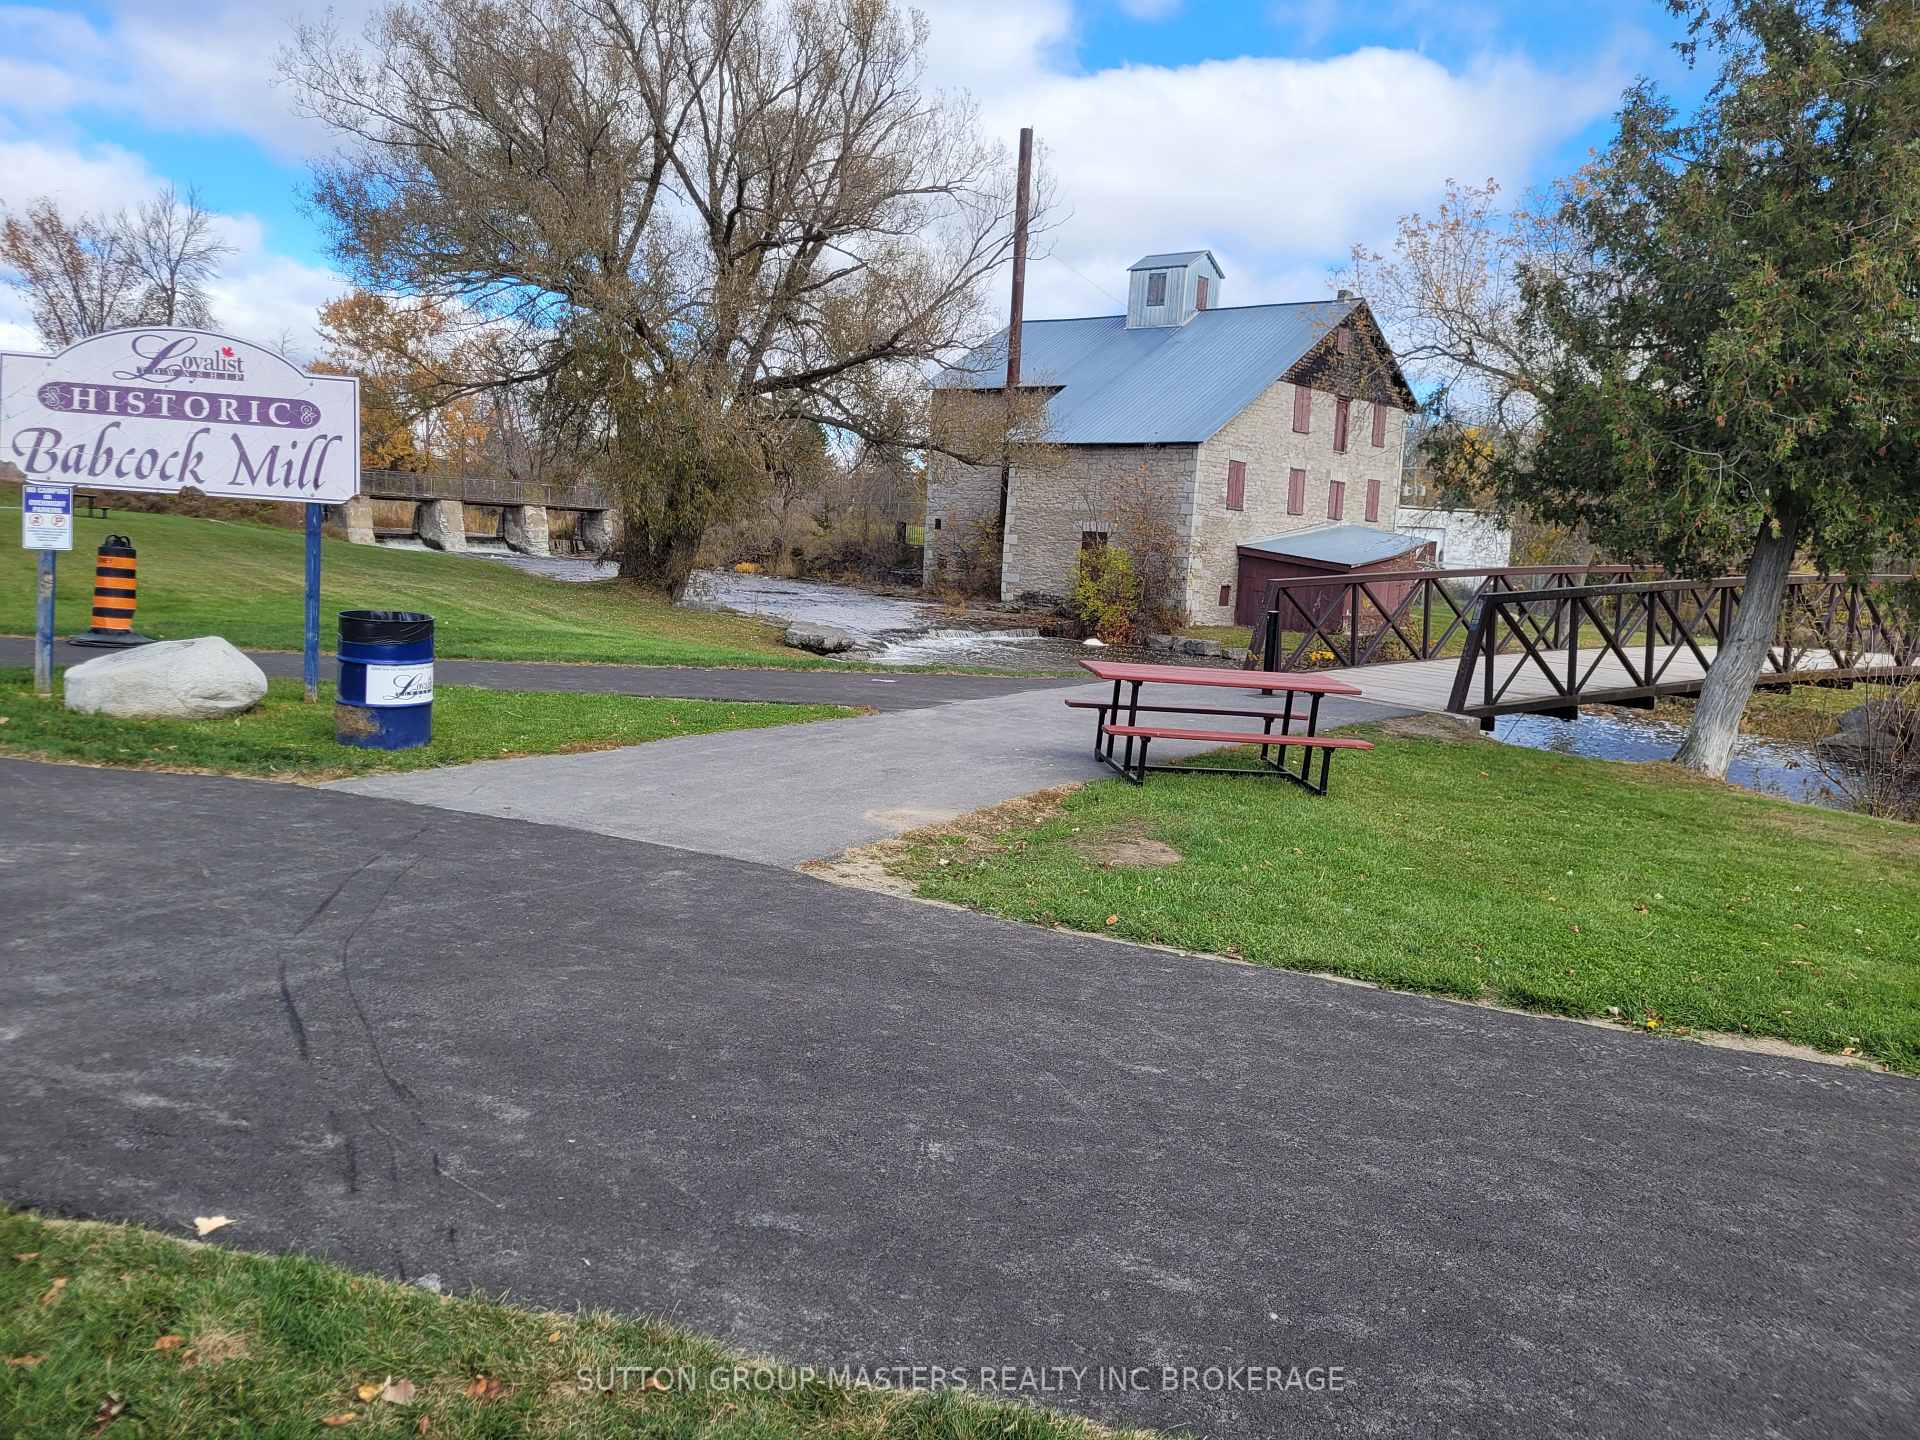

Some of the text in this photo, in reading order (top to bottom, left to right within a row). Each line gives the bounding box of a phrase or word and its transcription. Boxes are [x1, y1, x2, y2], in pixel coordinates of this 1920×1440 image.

[113, 334, 245, 383] Loyalist
[71, 387, 291, 425] HISTORIC
[12, 421, 343, 491] Babcock Mill
